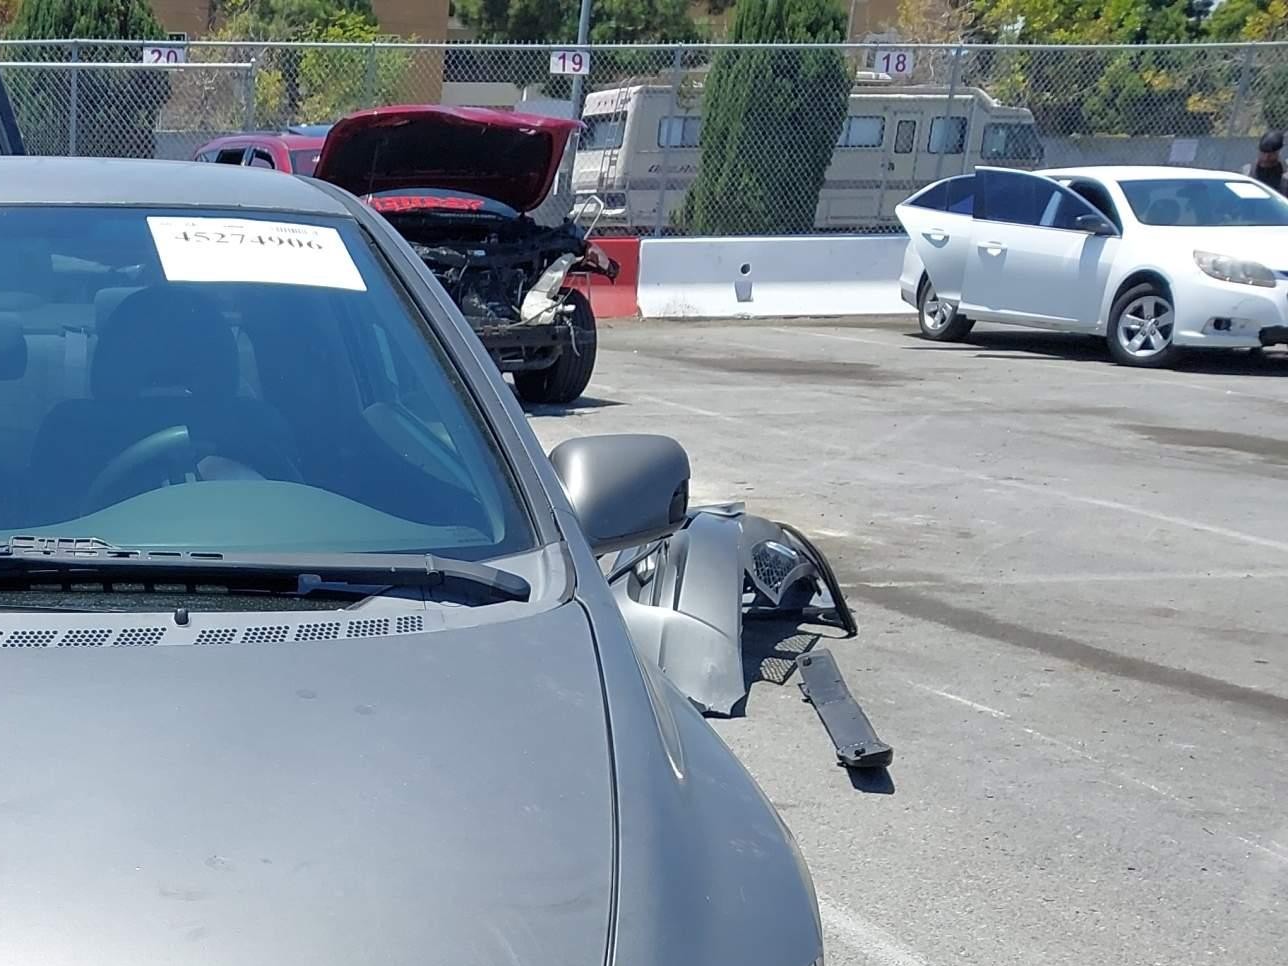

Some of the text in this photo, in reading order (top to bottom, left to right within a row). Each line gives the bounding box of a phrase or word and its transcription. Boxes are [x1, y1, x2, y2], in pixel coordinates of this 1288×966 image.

[150, 49, 178, 63] 20
[558, 52, 583, 73] 19
[882, 53, 907, 73] 18
[175, 230, 324, 250] 45274906
